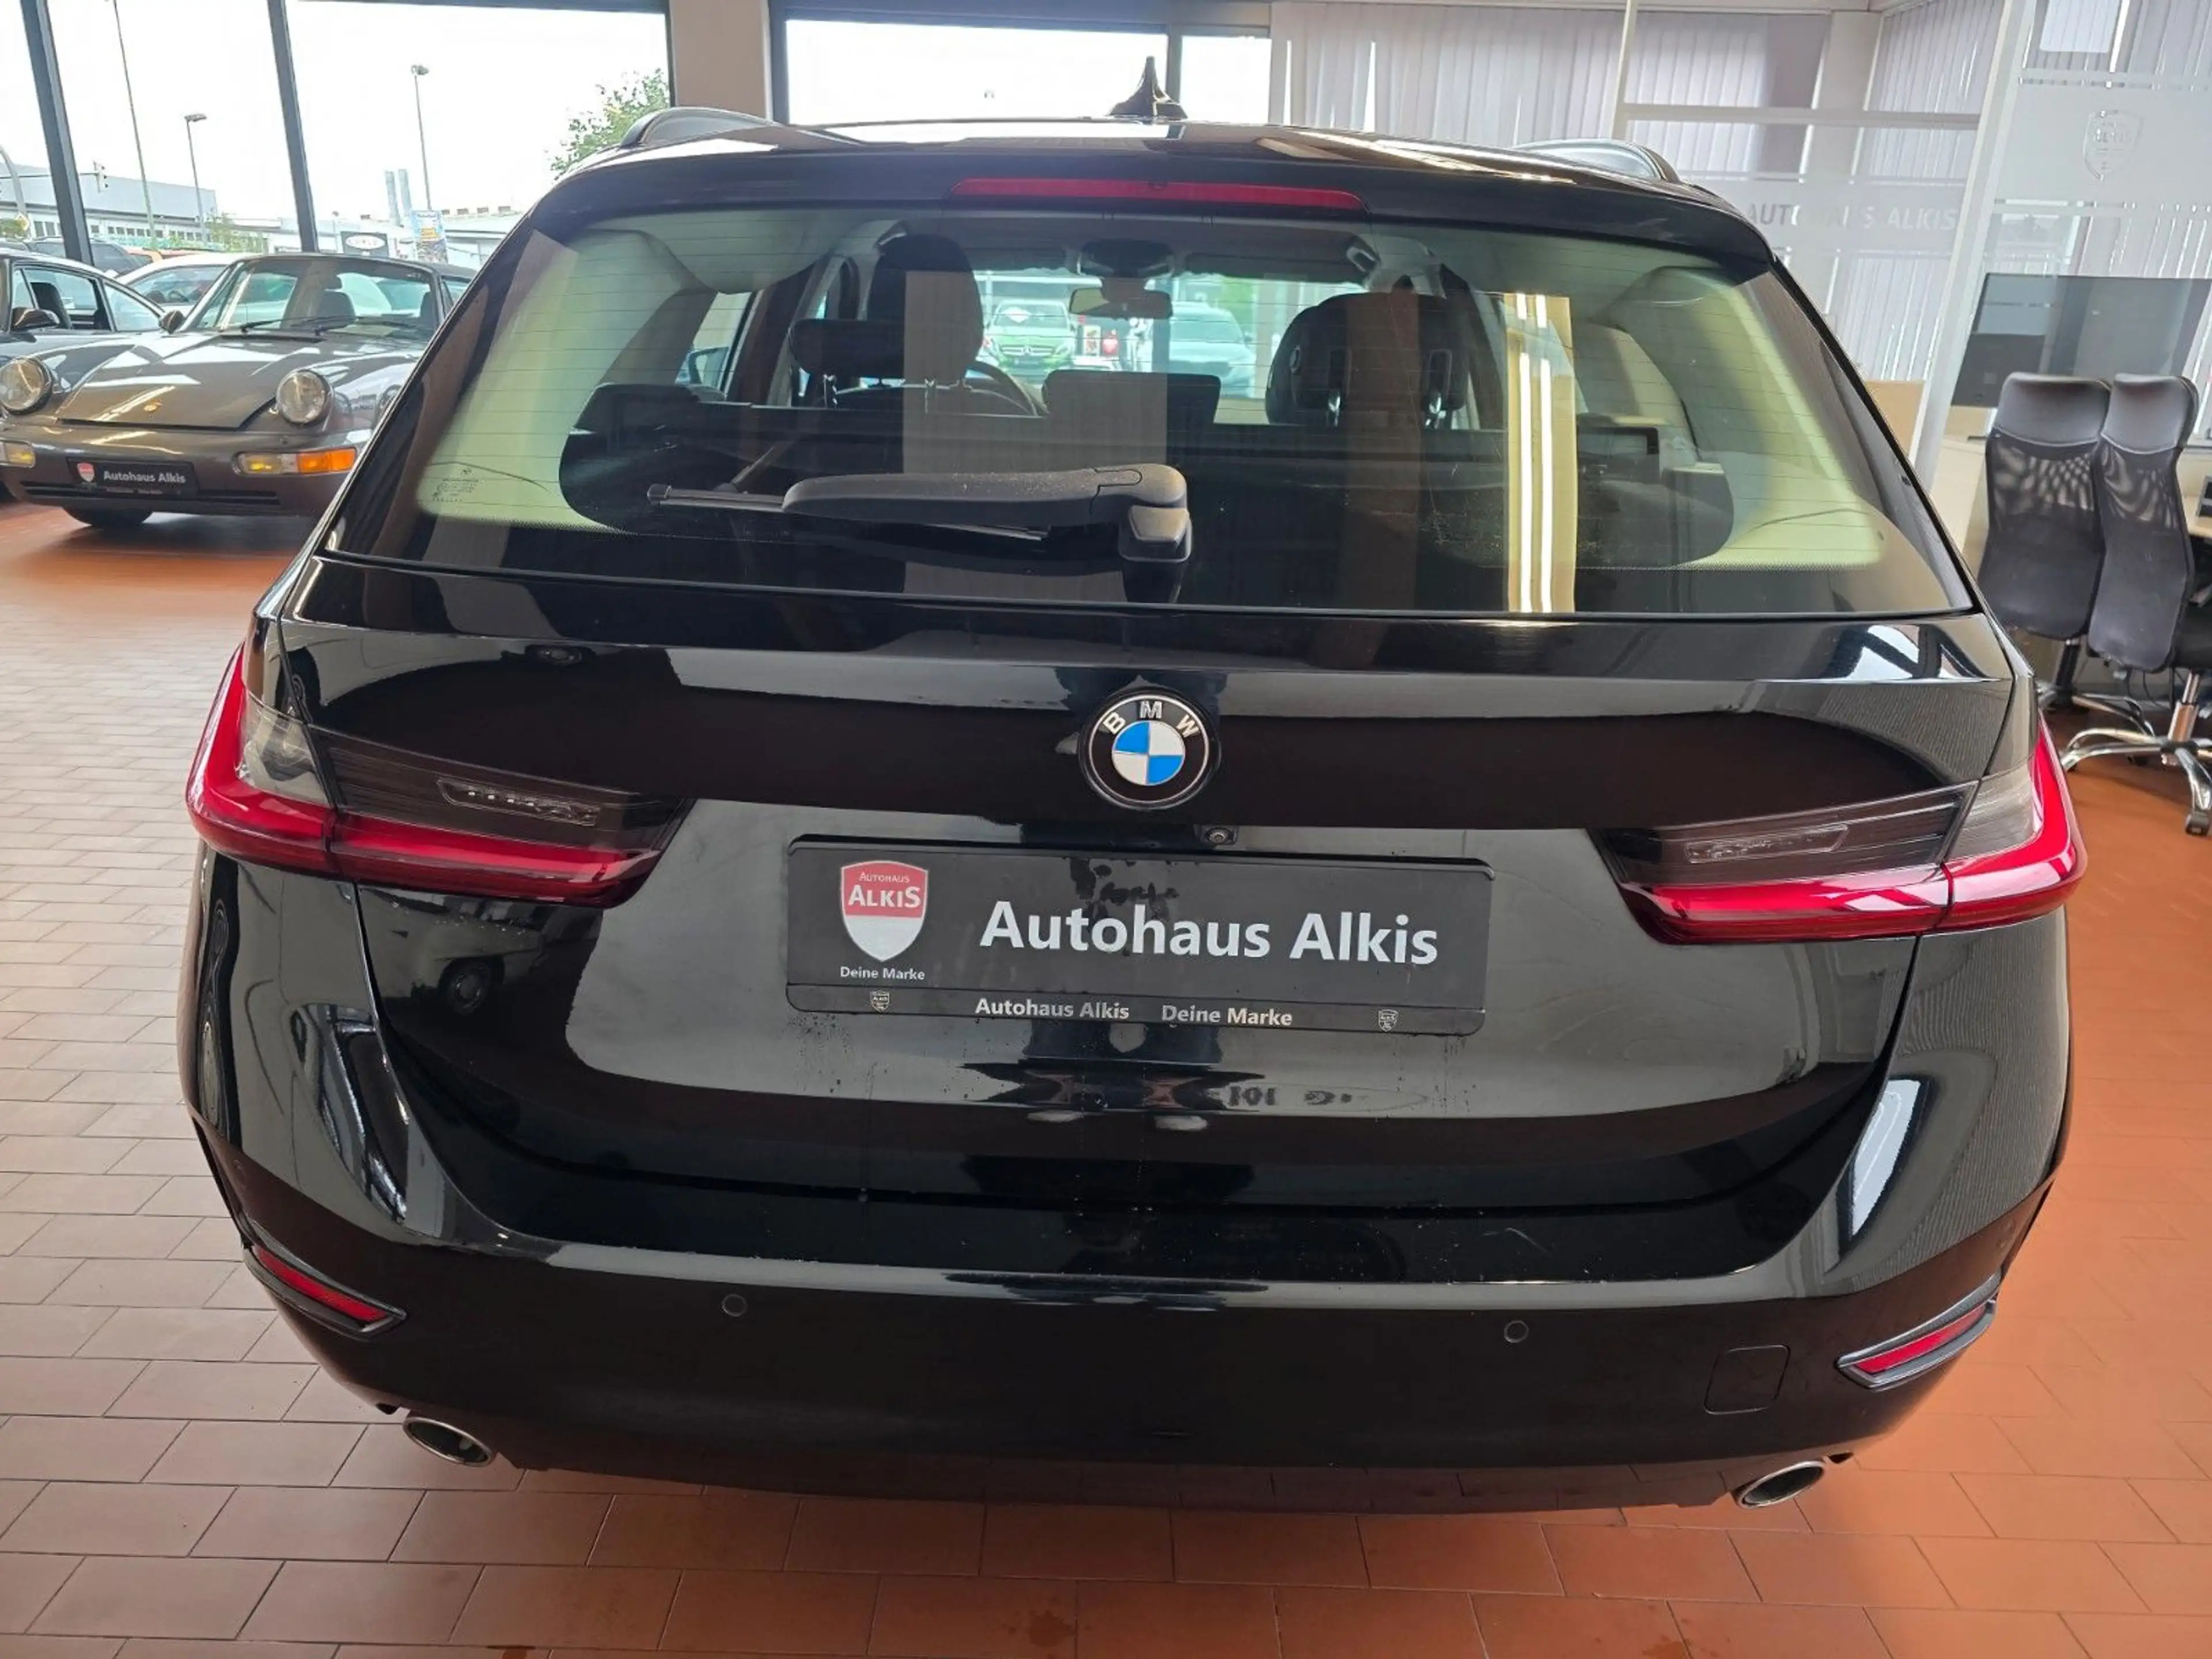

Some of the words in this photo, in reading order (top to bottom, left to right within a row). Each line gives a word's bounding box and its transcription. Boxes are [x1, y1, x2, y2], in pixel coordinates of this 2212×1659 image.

[1887, 207, 1959, 230] ALKIS
[104, 471, 155, 482] Autohaus
[158, 472, 185, 483] Alkis
[1103, 700, 1200, 738] BMW
[859, 873, 910, 883] AUTOHAUS
[848, 885, 921, 908] ALKIS
[979, 900, 1271, 958] Autohaus
[1290, 911, 1438, 965] Alkis
[840, 966, 879, 979] Deine
[883, 968, 926, 980] Marke
[975, 998, 1074, 1017] Autohaus
[1080, 1002, 1130, 1020] Alkis
[1161, 1005, 1220, 1023] Deine
[1227, 1007, 1293, 1026] Marke
